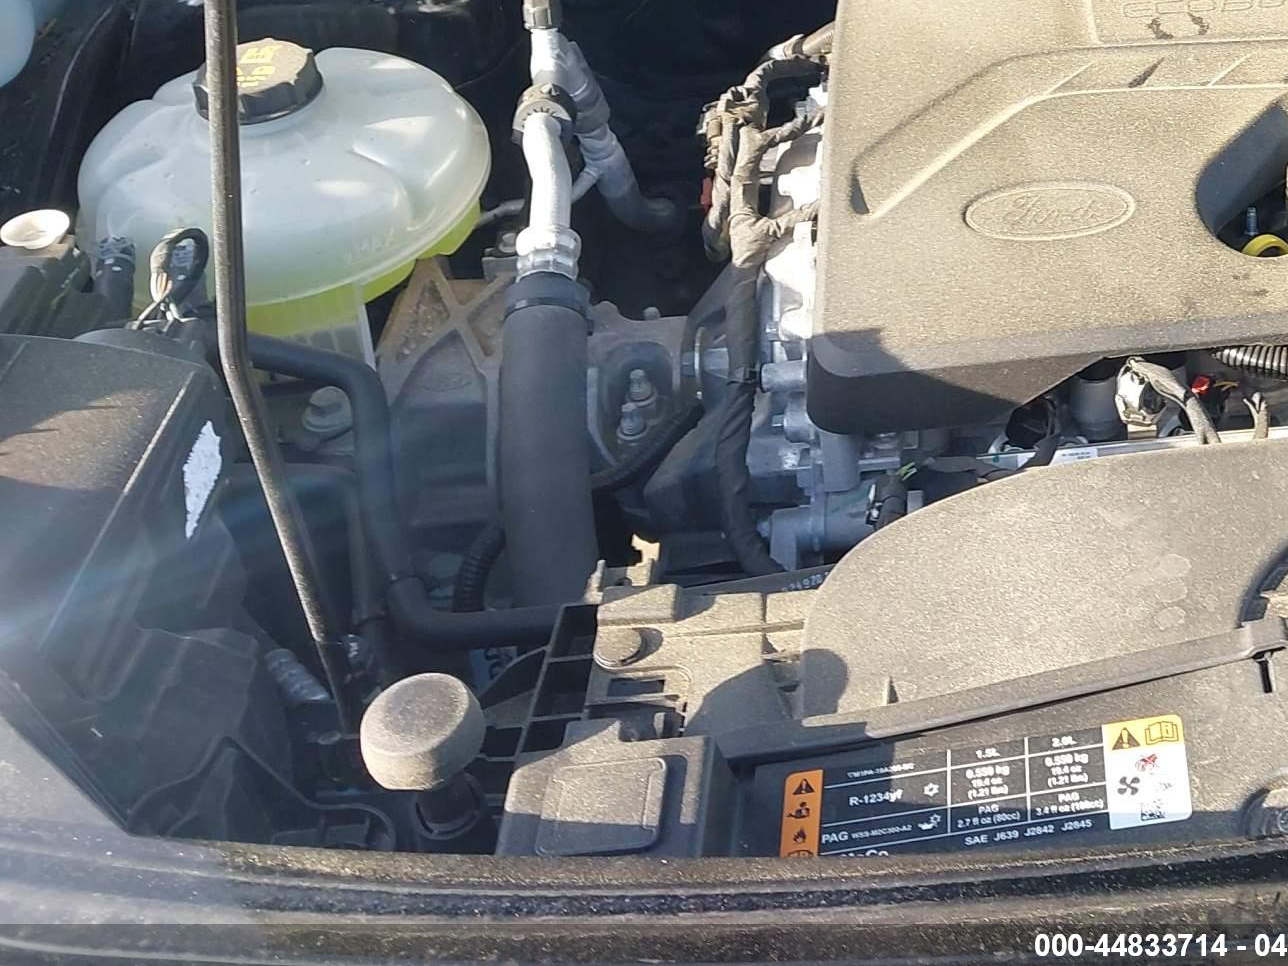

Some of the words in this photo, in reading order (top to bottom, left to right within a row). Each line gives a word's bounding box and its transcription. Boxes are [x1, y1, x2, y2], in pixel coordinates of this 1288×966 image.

[849, 789, 904, 806] R-1234yf
[1058, 792, 1080, 803] PAG
[978, 804, 1000, 815] PAG
[957, 817, 971, 828] 2.7
[980, 817, 992, 825] oz
[821, 831, 849, 844] PAG
[964, 835, 989, 846] SAE
[993, 830, 1020, 842] J639
[1024, 825, 1055, 837] J2842
